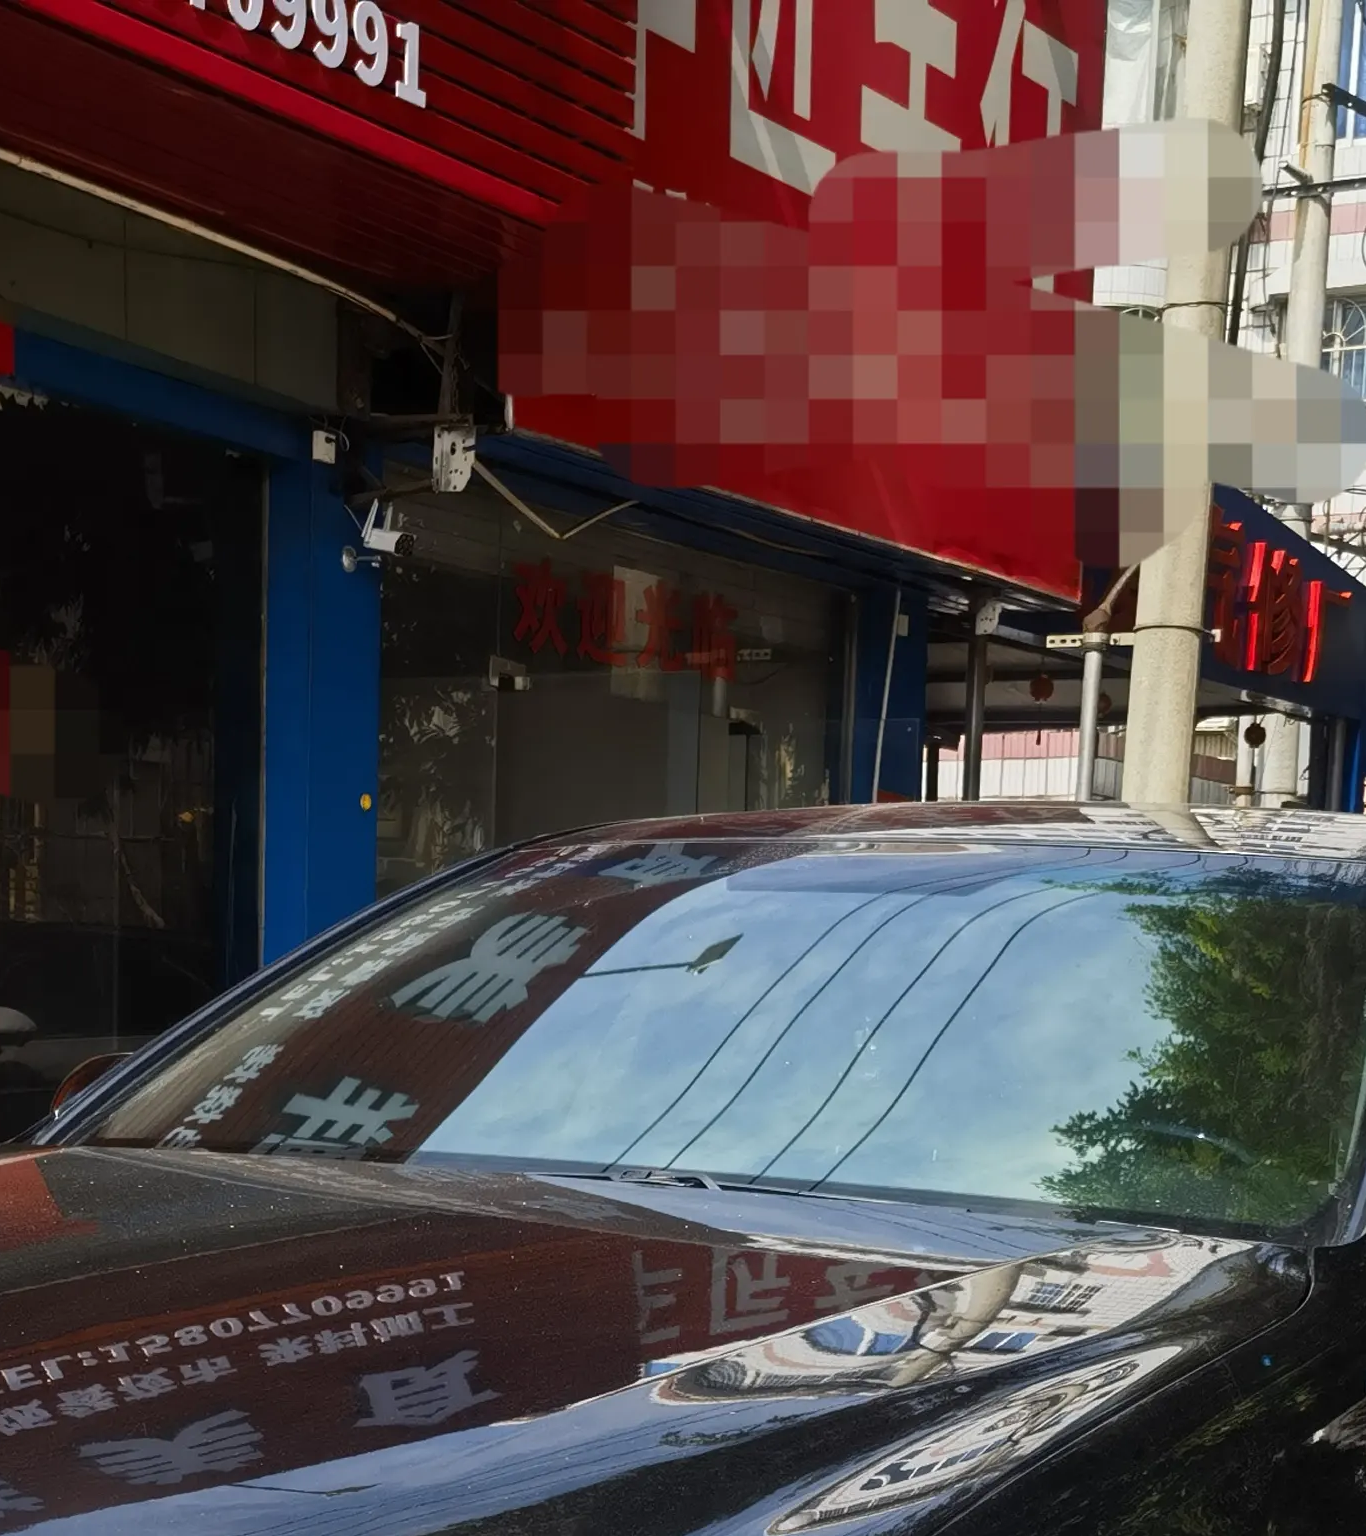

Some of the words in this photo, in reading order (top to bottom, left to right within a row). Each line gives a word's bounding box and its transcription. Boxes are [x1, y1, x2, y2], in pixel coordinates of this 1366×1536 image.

[188, 0, 428, 109] 9991
[511, 556, 739, 684] 欢迎光临
